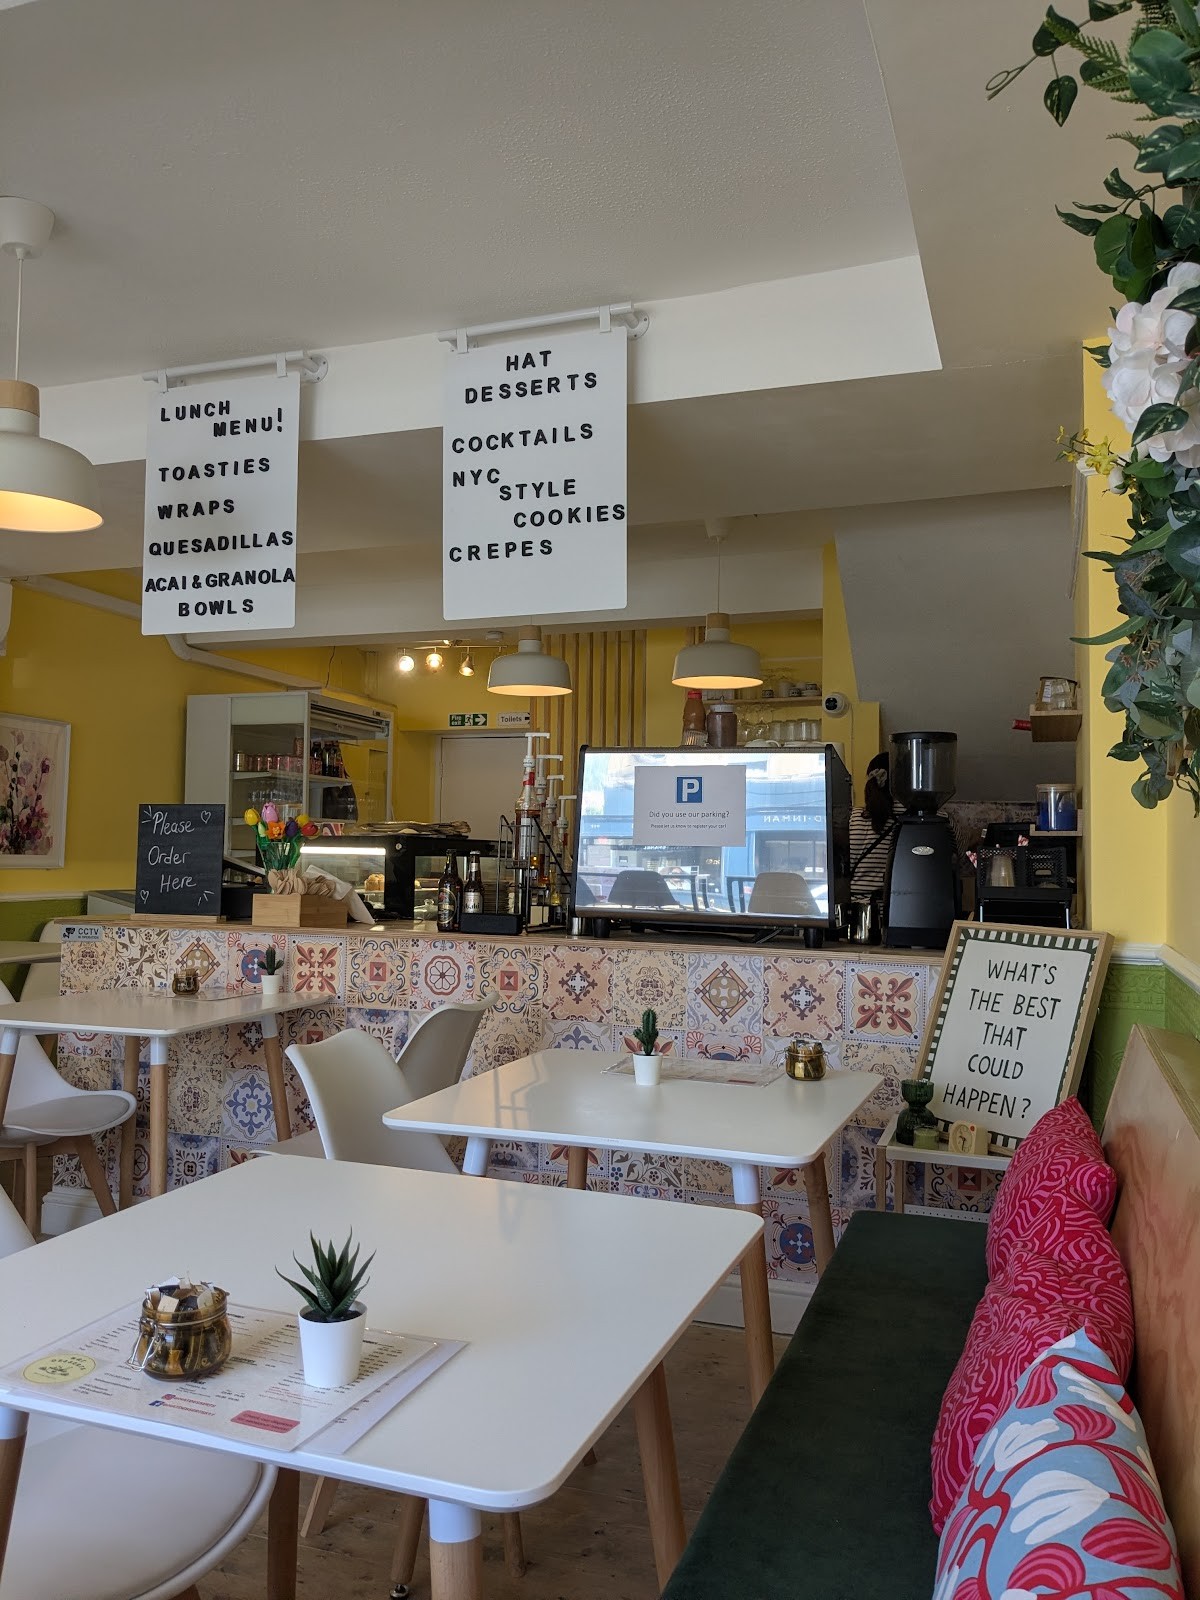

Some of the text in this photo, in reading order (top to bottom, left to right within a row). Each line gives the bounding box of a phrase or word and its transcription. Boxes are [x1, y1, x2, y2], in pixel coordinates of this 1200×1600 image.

[507, 351, 551, 371] HAT
[466, 373, 596, 404] DESSERTS
[161, 401, 229, 421] LUNCH
[213, 408, 283, 437] MENU!
[452, 424, 592, 453] COCKTAILS
[159, 458, 269, 482] TOASTIES
[453, 469, 499, 487] NYC
[500, 479, 575, 500] STYLE
[158, 499, 234, 519] WRAPS
[514, 504, 625, 527] COOKIES
[149, 531, 293, 555] QUESADILLAS
[450, 540, 552, 562] CREPES
[179, 599, 253, 616] BOWLS
[682, 779, 699, 801] P
[153, 811, 195, 835] Please
[148, 846, 191, 866] Order
[160, 874, 196, 893] Here
[989, 960, 1056, 984] WHAT'S
[970, 989, 1061, 1019] THE BEST
[983, 1022, 1027, 1050] THAT
[968, 1054, 1023, 1079] COULD
